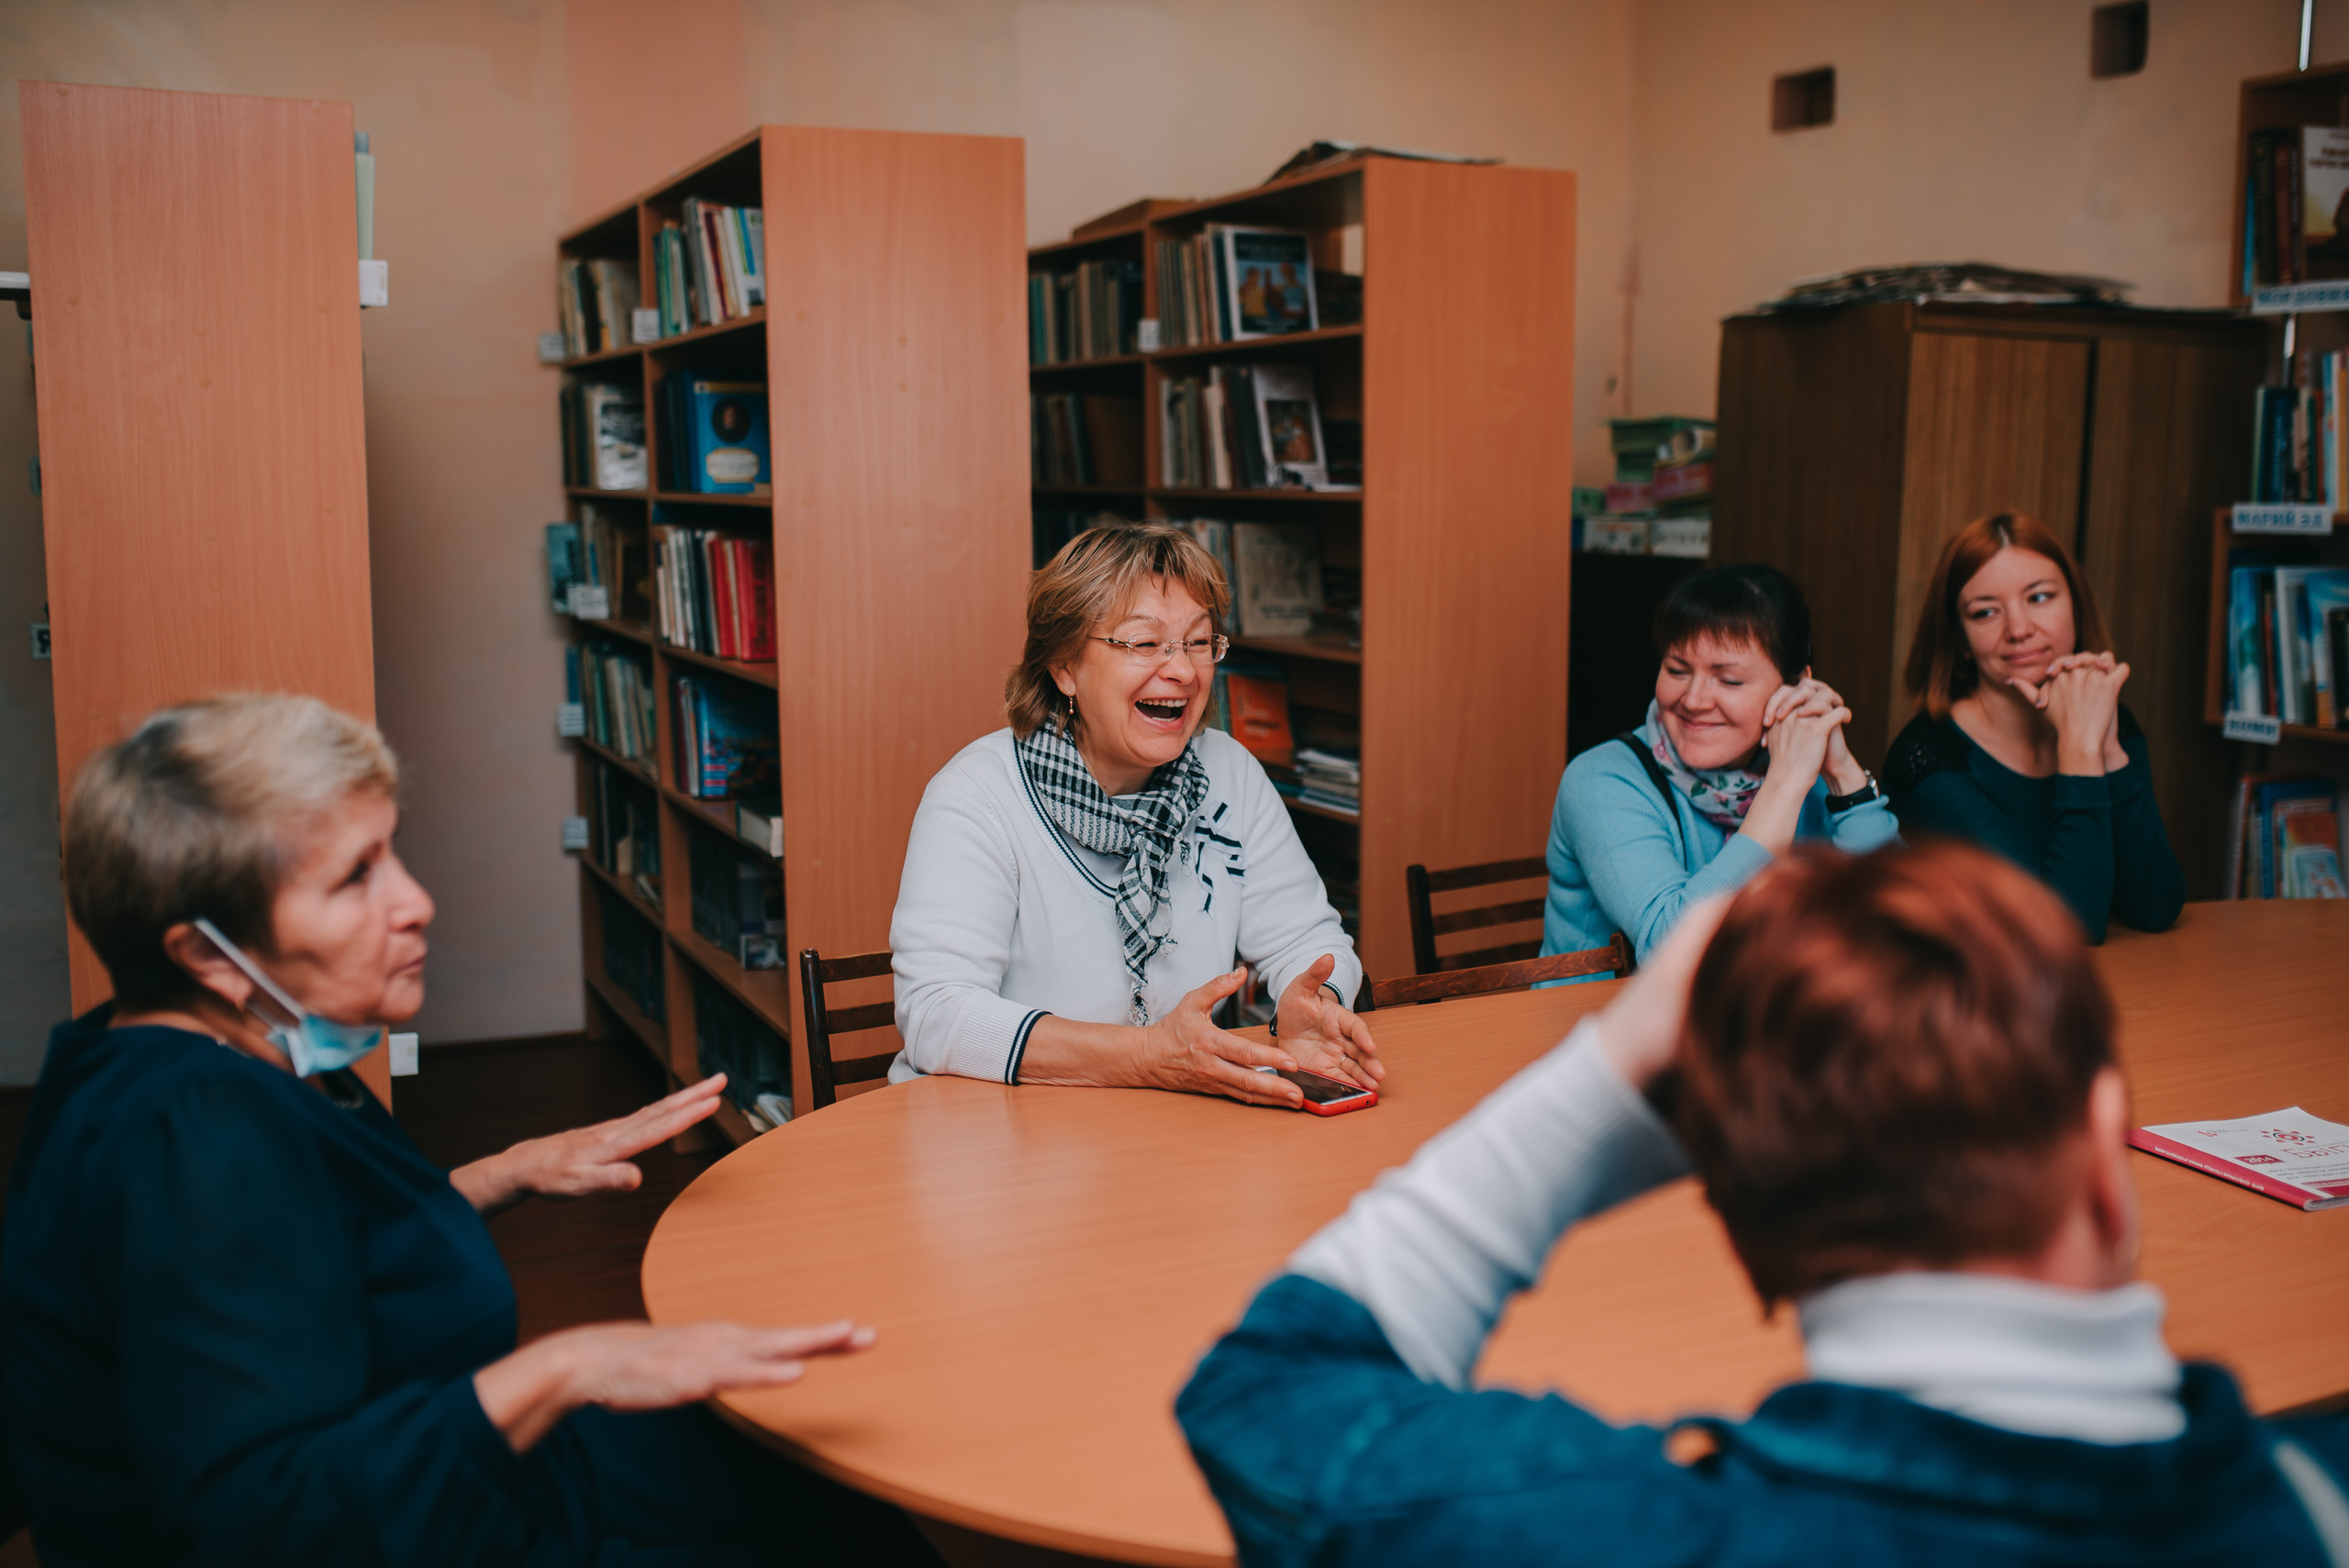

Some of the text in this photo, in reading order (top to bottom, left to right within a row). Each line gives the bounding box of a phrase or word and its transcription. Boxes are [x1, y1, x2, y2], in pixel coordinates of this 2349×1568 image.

[2237, 509, 2296, 527] МАРИЙ
[2243, 1155, 2276, 1165] 2014
[2203, 1164, 2224, 1176] СТОЛИЦА
